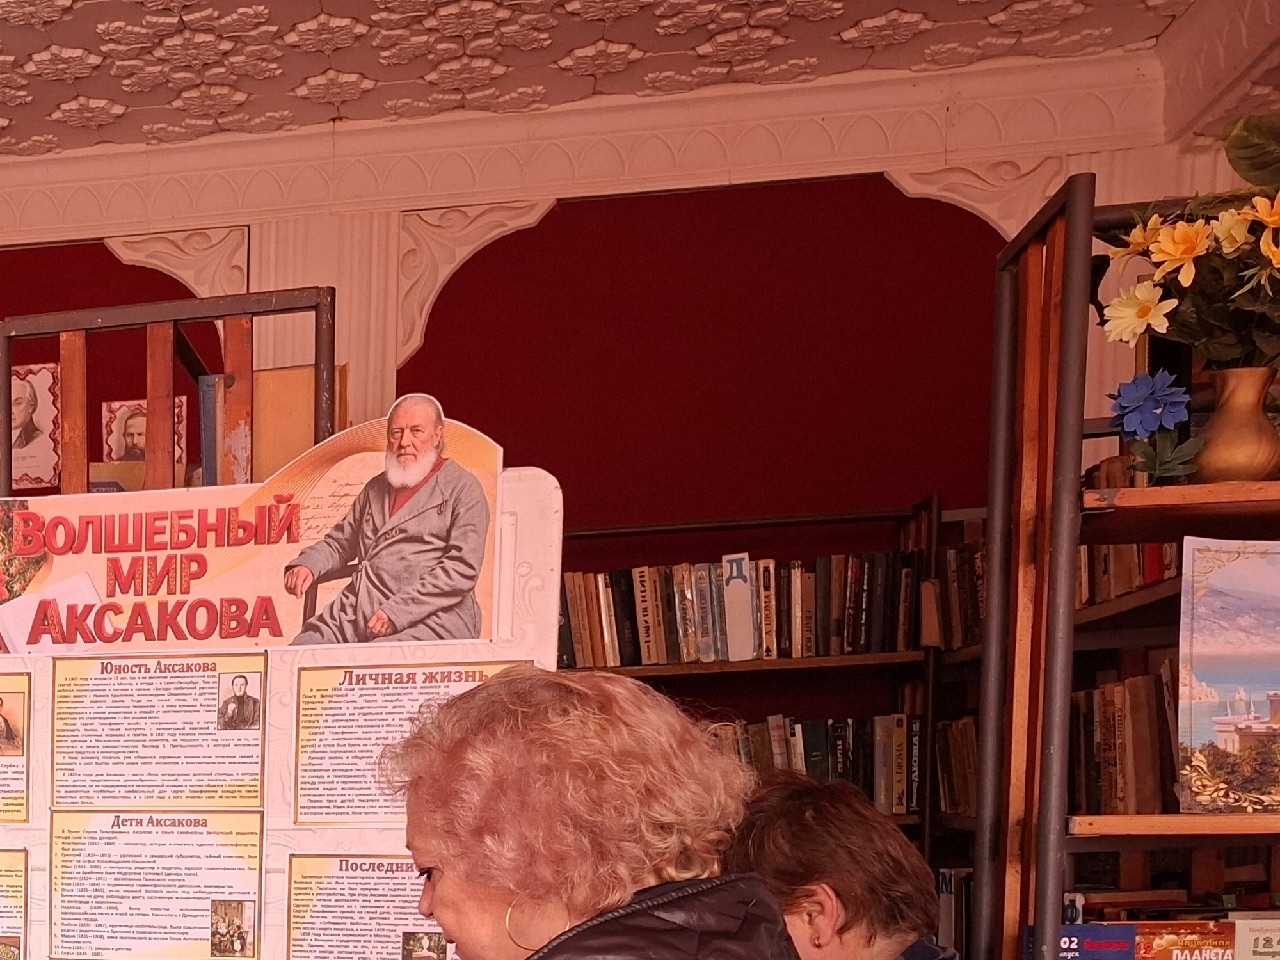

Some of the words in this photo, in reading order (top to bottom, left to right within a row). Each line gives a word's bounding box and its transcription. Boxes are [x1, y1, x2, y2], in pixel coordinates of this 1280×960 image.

[11, 492, 302, 559] ВОЛШЕБНЫЙ
[105, 553, 208, 598] МИР
[726, 557, 748, 586] Д
[25, 596, 285, 648] АКСАКОВА
[99, 661, 151, 675] Юность
[154, 660, 217, 673] Аксакова
[339, 670, 418, 686] Личная
[422, 669, 489, 684] жизнь
[111, 816, 144, 829] Дети
[147, 815, 208, 828] Аксакова
